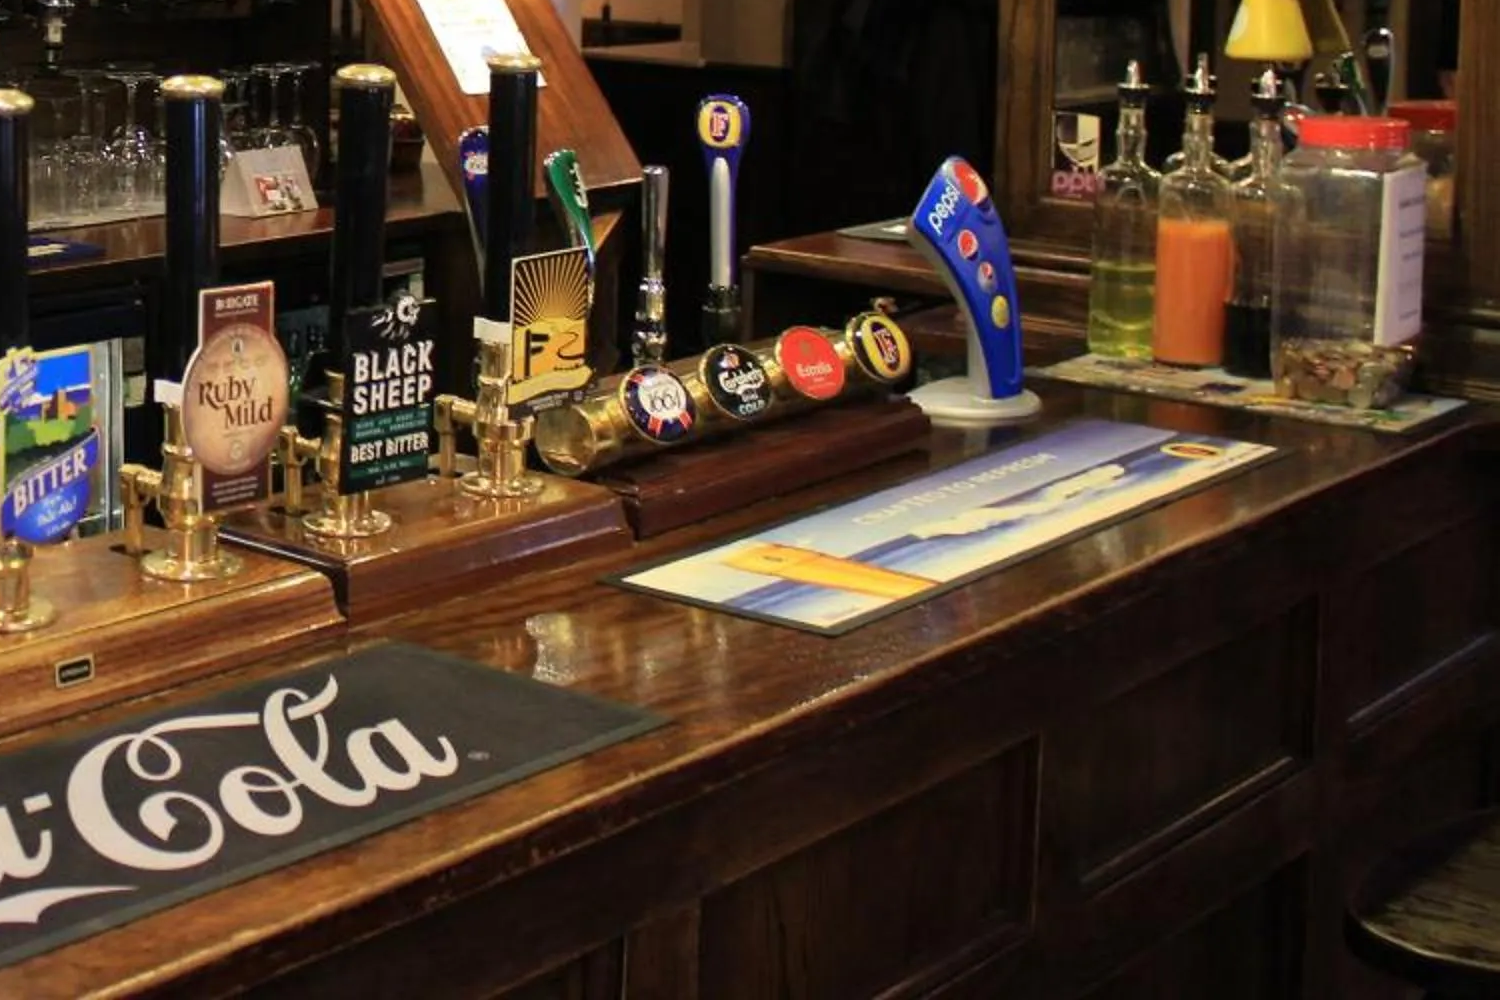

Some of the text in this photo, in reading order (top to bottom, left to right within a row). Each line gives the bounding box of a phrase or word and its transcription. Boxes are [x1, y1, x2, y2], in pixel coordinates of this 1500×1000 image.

[928, 178, 960, 236] pepsi
[353, 340, 434, 383] BLACK
[198, 375, 256, 409] Ruby
[352, 374, 432, 415] SHEEP
[225, 396, 273, 430] Mild
[351, 431, 429, 464] BEST BITTER
[13, 448, 88, 519] BITTER
